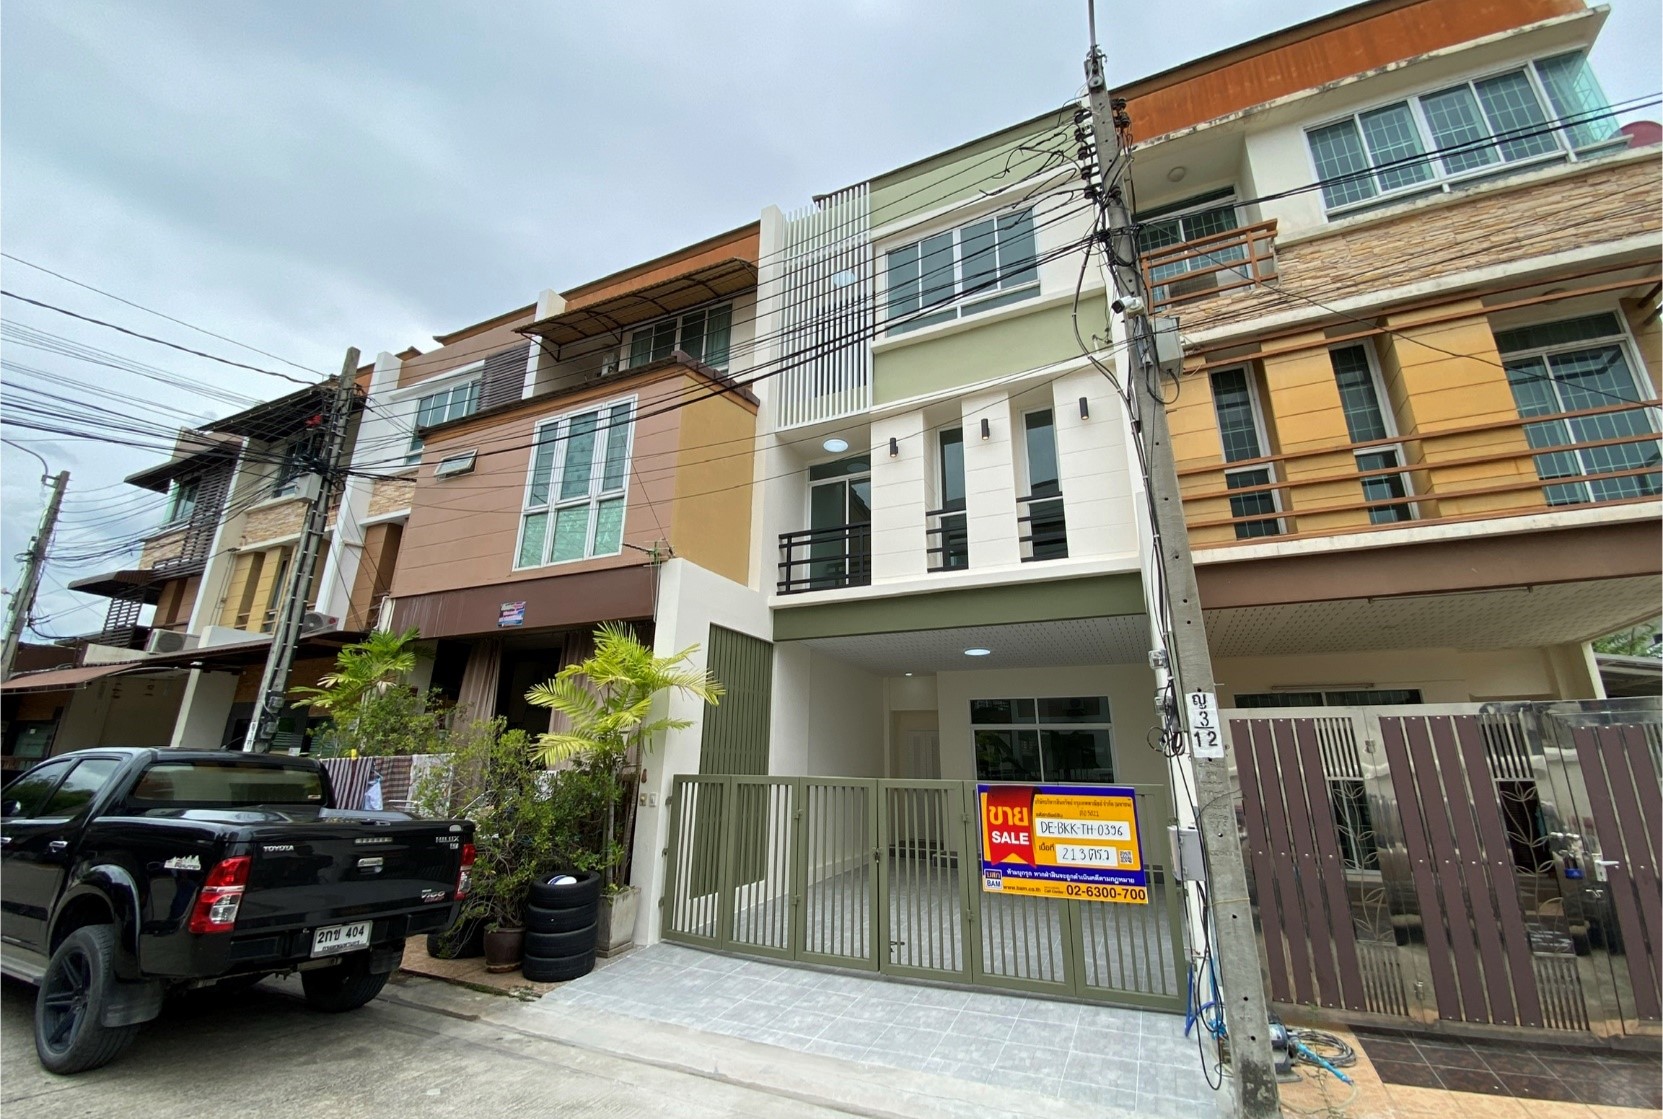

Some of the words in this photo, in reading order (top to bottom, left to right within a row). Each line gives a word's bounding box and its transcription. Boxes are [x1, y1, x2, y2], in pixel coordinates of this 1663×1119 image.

[1199, 710, 1210, 727] 3
[1194, 731, 1218, 748] 12
[989, 805, 1029, 827] ขาย
[991, 830, 1030, 846] SALE
[263, 845, 295, 853] TOYOTA
[986, 879, 1001, 888] BAM
[1066, 884, 1146, 901] 02-6300-700
